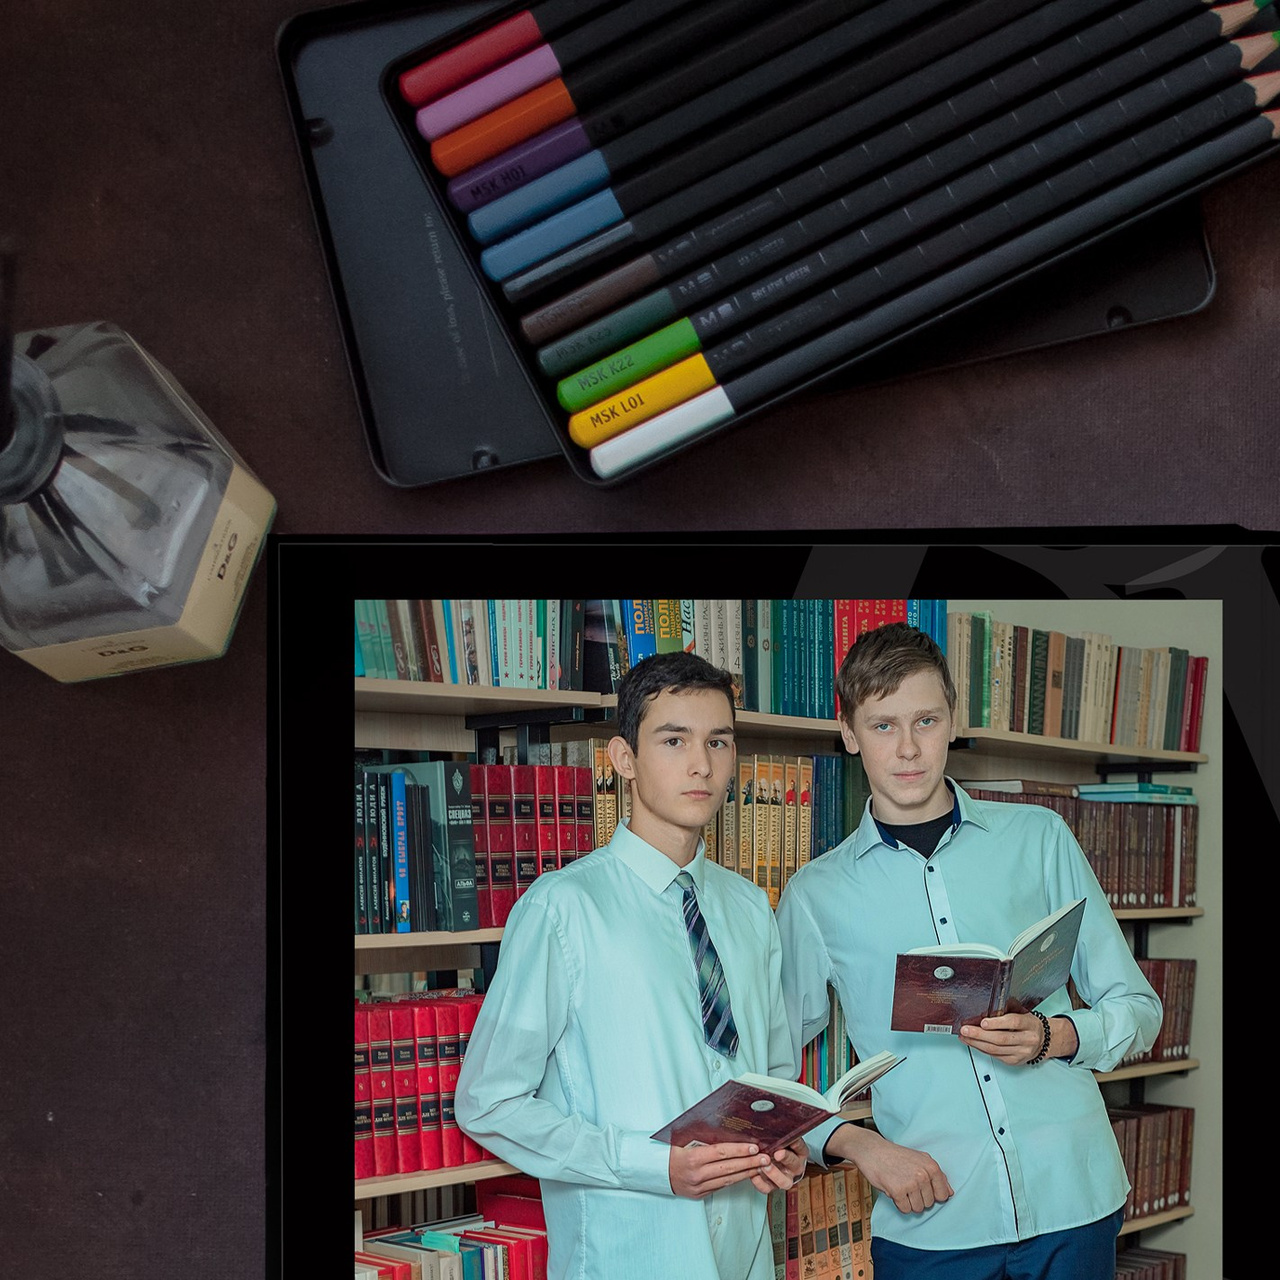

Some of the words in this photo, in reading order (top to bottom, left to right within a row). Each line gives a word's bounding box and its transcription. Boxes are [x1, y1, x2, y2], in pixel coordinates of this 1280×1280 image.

[470, 177, 500, 200] MSK
[578, 367, 607, 391] MSK
[609, 354, 635, 378] K22
[590, 404, 620, 429] MSK
[620, 393, 646, 417] L01
[734, 656, 740, 669] 4
[448, 809, 471, 820] СПЕЦНАЗ
